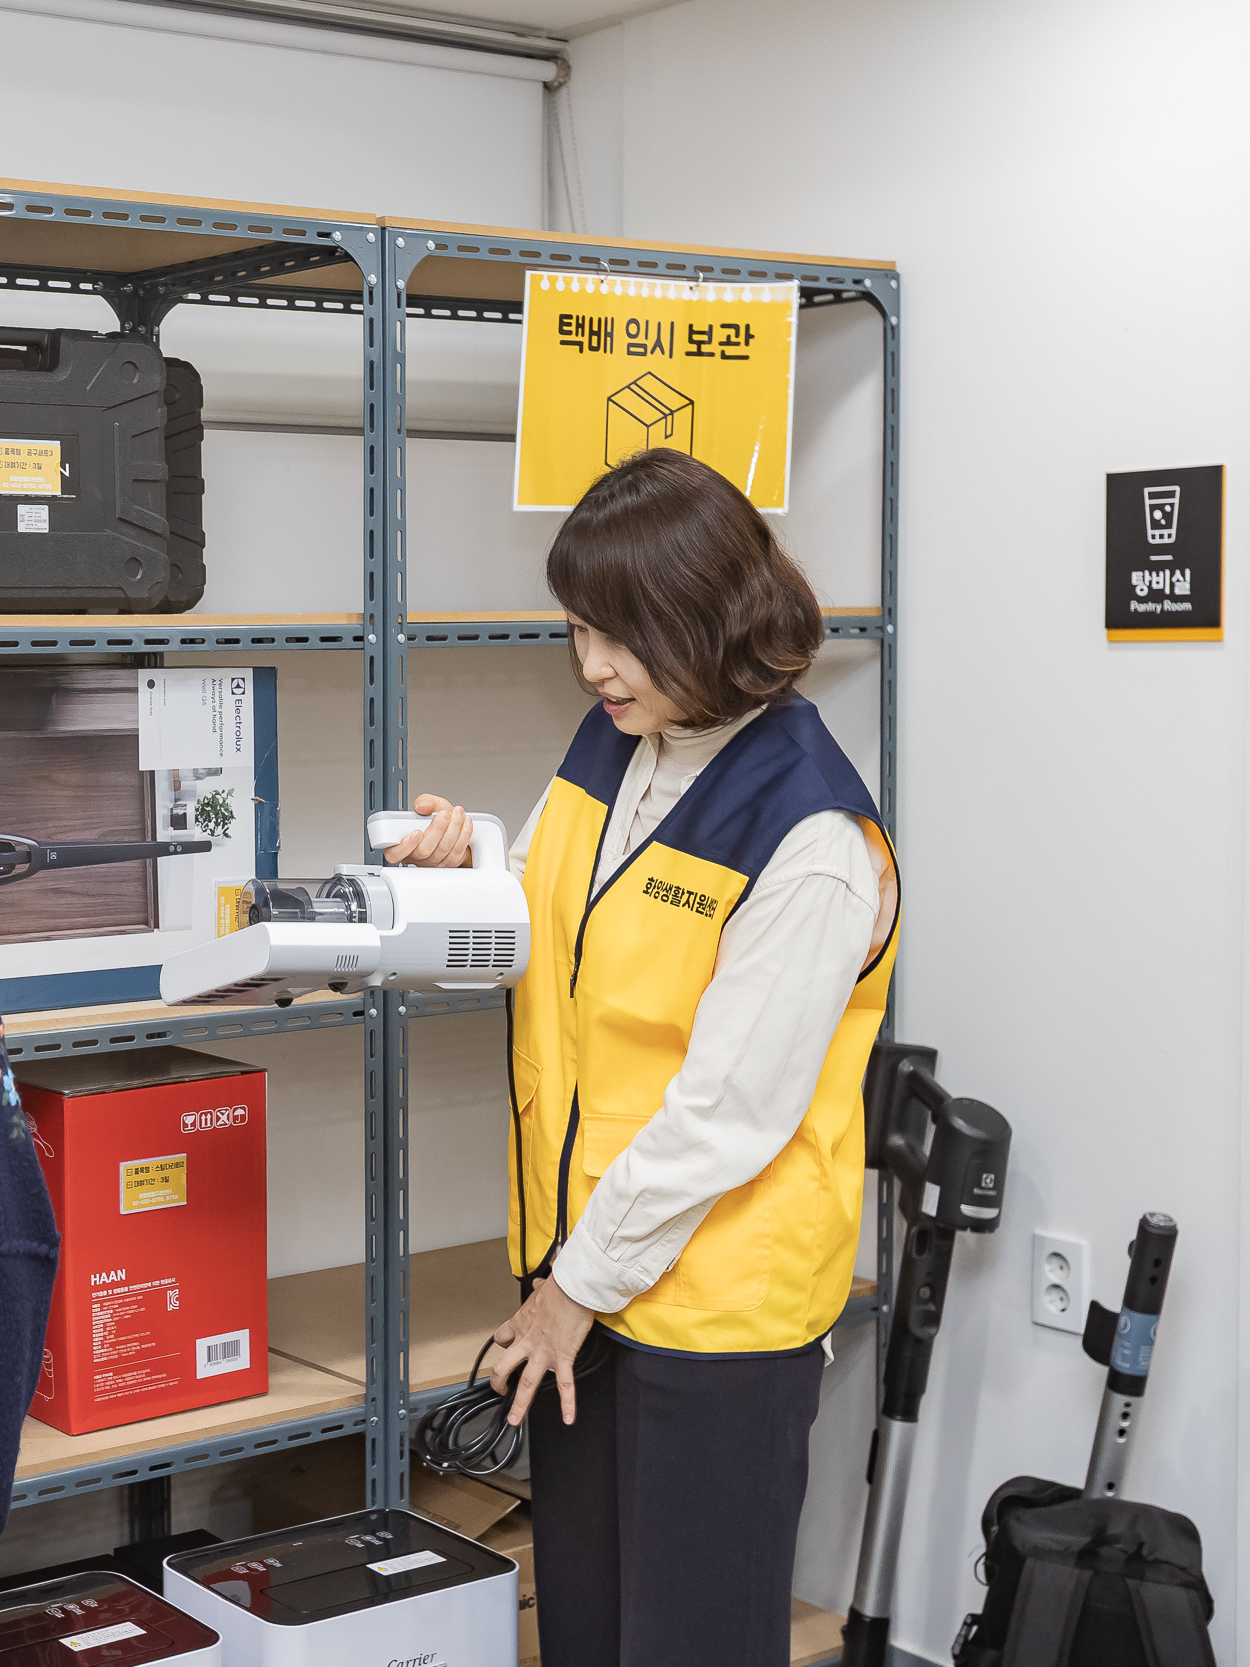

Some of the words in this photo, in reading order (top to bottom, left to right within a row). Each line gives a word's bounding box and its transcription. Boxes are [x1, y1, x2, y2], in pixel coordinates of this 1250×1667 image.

[558, 314, 615, 355] 택배
[625, 318, 675, 359] 임시
[685, 323, 756, 361] 보관
[4, 461, 27, 470] 대여기간
[32, 462, 43, 470] 3일
[1131, 568, 1191, 597] 탕비실
[1130, 600, 1162, 614] Pantry
[1163, 599, 1192, 612] Room
[212, 705, 217, 713] at
[234, 698, 243, 753] Electrolux
[90, 1268, 126, 1286] HAAN
